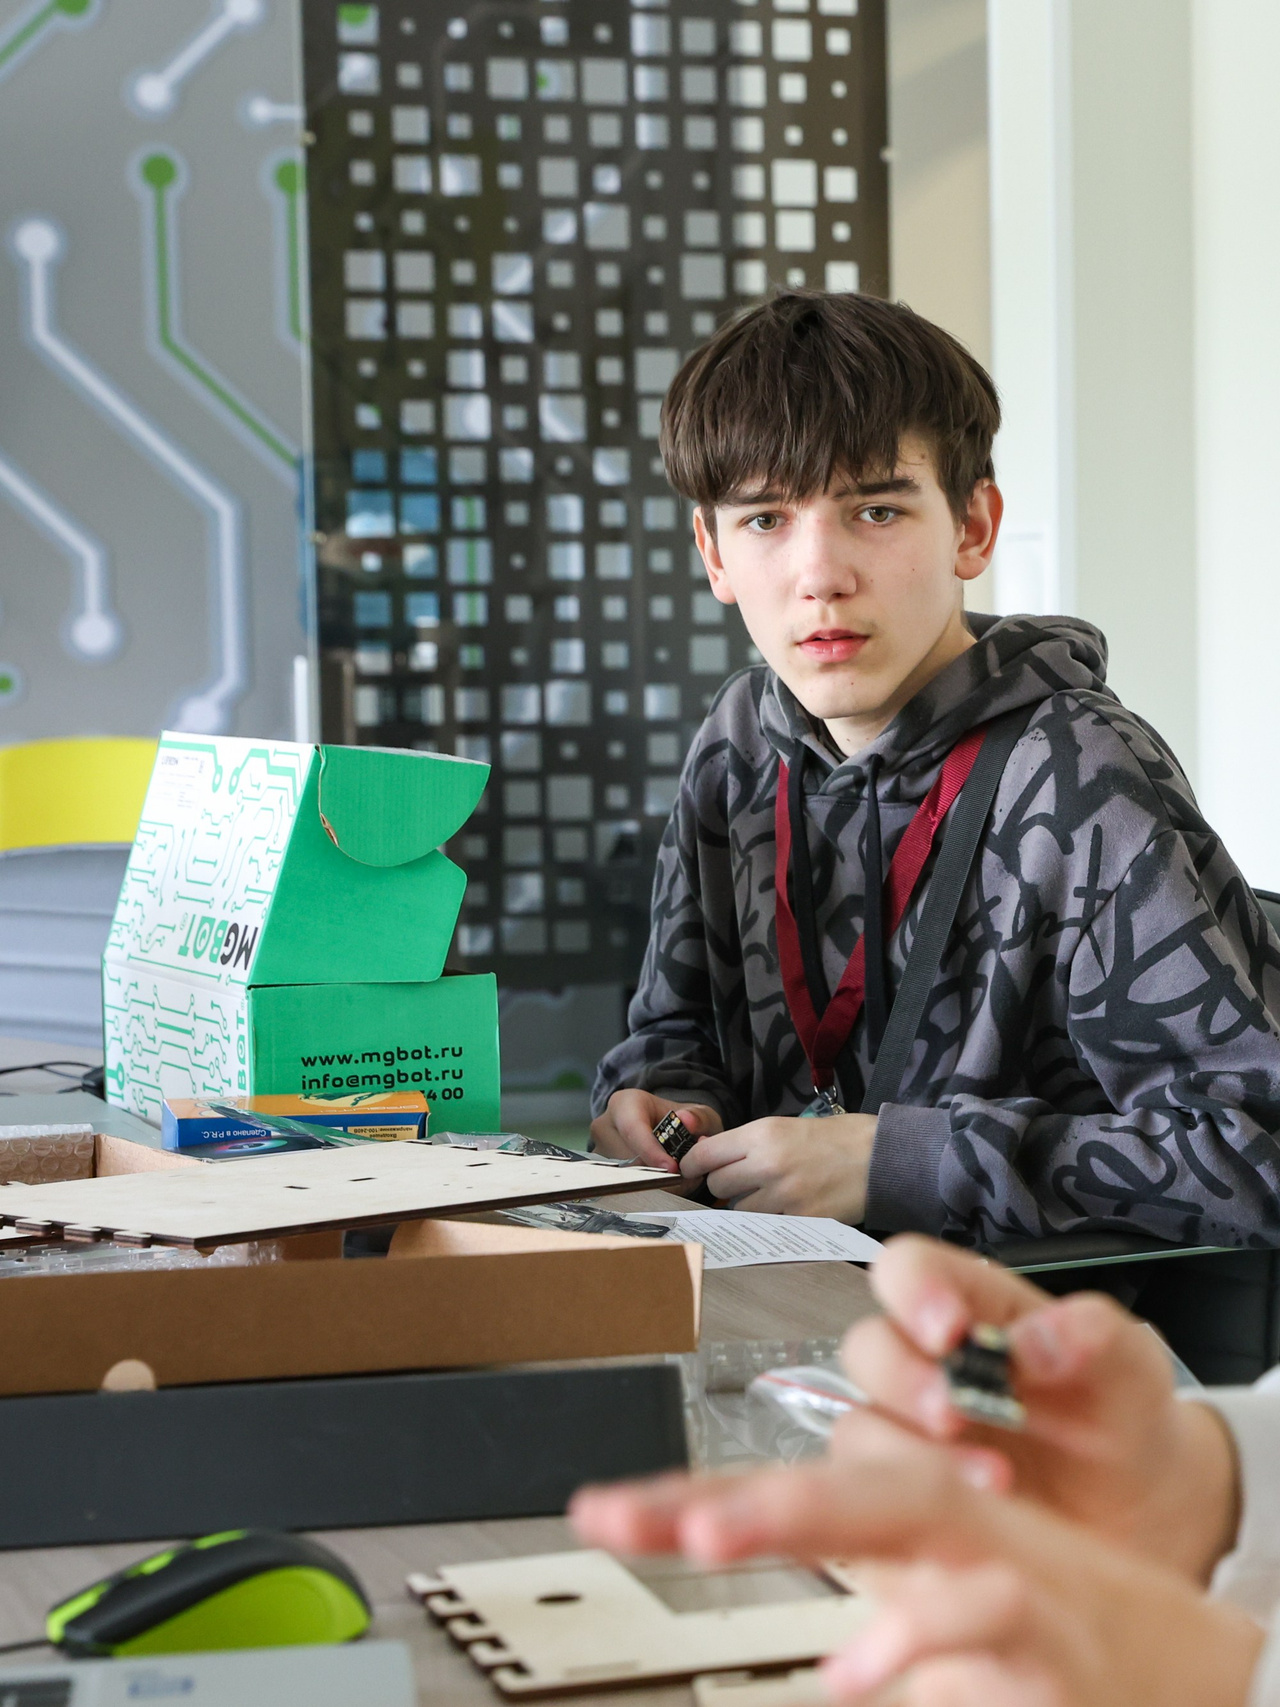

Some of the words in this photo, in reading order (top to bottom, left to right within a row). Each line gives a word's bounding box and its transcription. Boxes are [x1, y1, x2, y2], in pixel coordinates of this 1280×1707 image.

[177, 913, 259, 971] MGBOT
[236, 1008, 248, 1097] BOT
[301, 1045, 463, 1067] www.mgbot.ru
[301, 1067, 464, 1090] info@mgbot.ru
[441, 1086, 464, 1101] 00
[232, 1129, 267, 1137] Сделано
